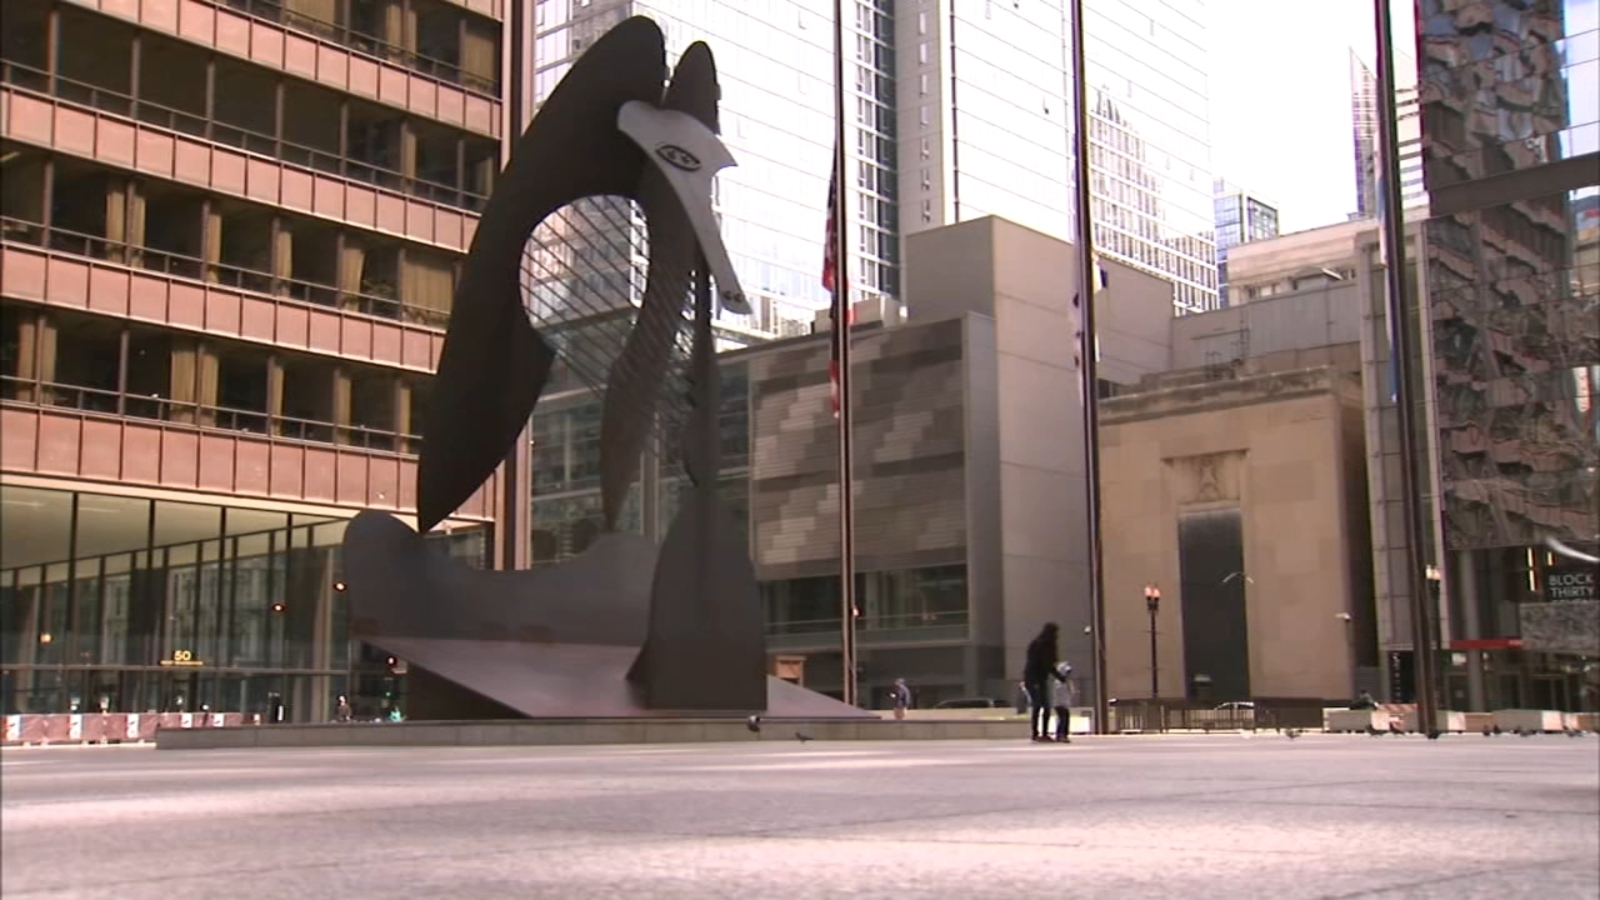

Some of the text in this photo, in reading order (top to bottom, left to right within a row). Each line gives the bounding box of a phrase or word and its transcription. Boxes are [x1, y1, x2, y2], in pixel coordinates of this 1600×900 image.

[1549, 574, 1594, 586] BLOCK
[1550, 586, 1594, 598] THIRTY
[174, 649, 191, 661] 50
